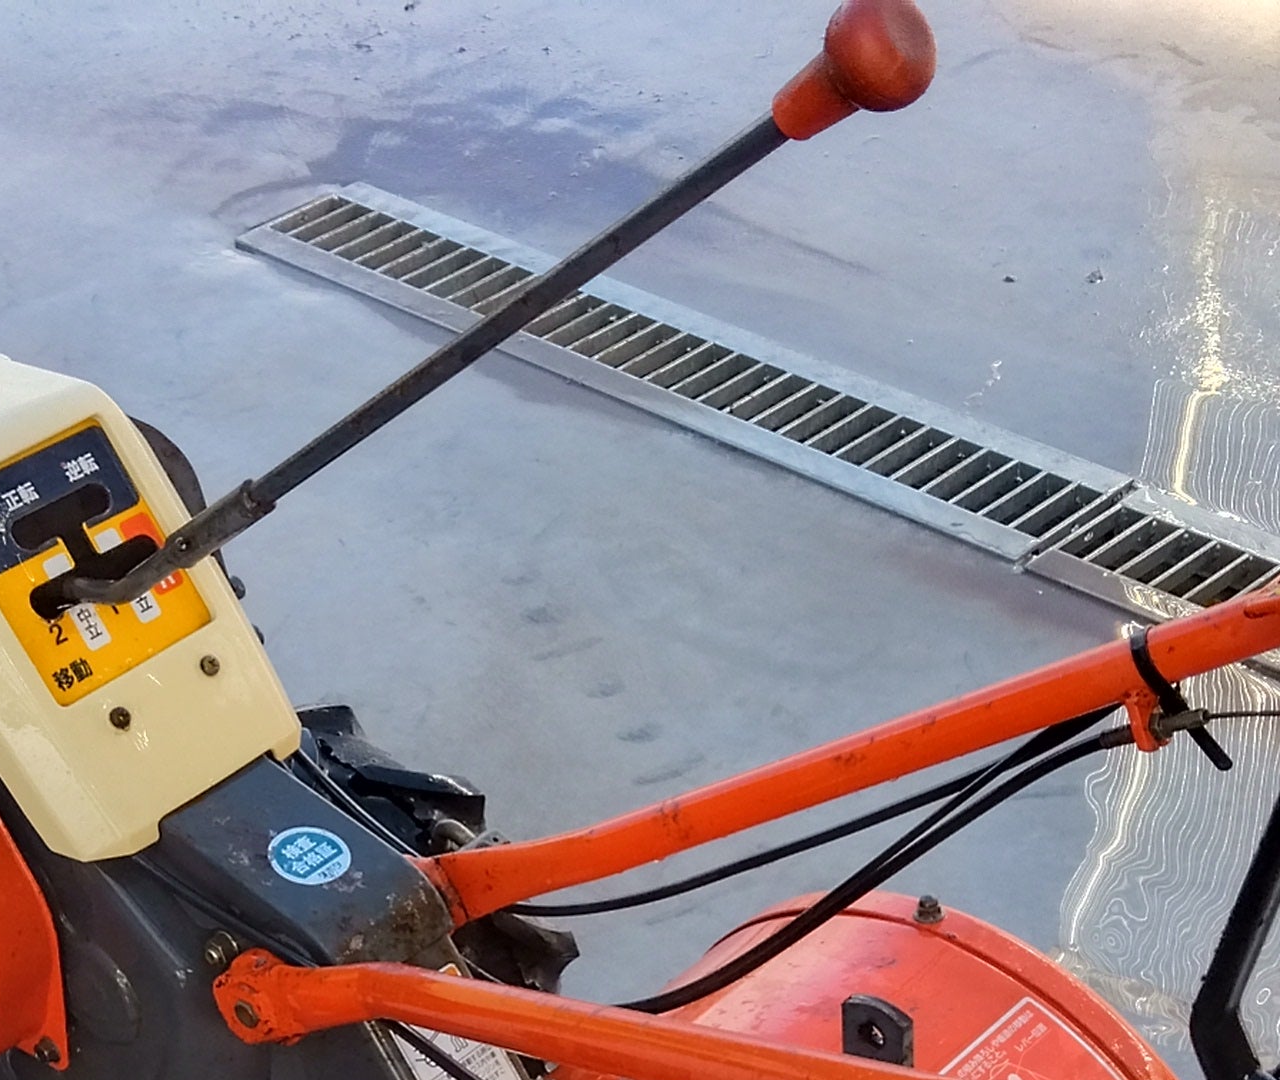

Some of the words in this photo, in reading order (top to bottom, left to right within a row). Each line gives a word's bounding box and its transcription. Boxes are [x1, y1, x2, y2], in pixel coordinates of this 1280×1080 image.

[64, 452, 99, 483] 逆転
[1, 481, 40, 511] 正転
[48, 623, 68, 646] 2
[76, 608, 103, 641] 中立
[51, 658, 93, 692] 移動
